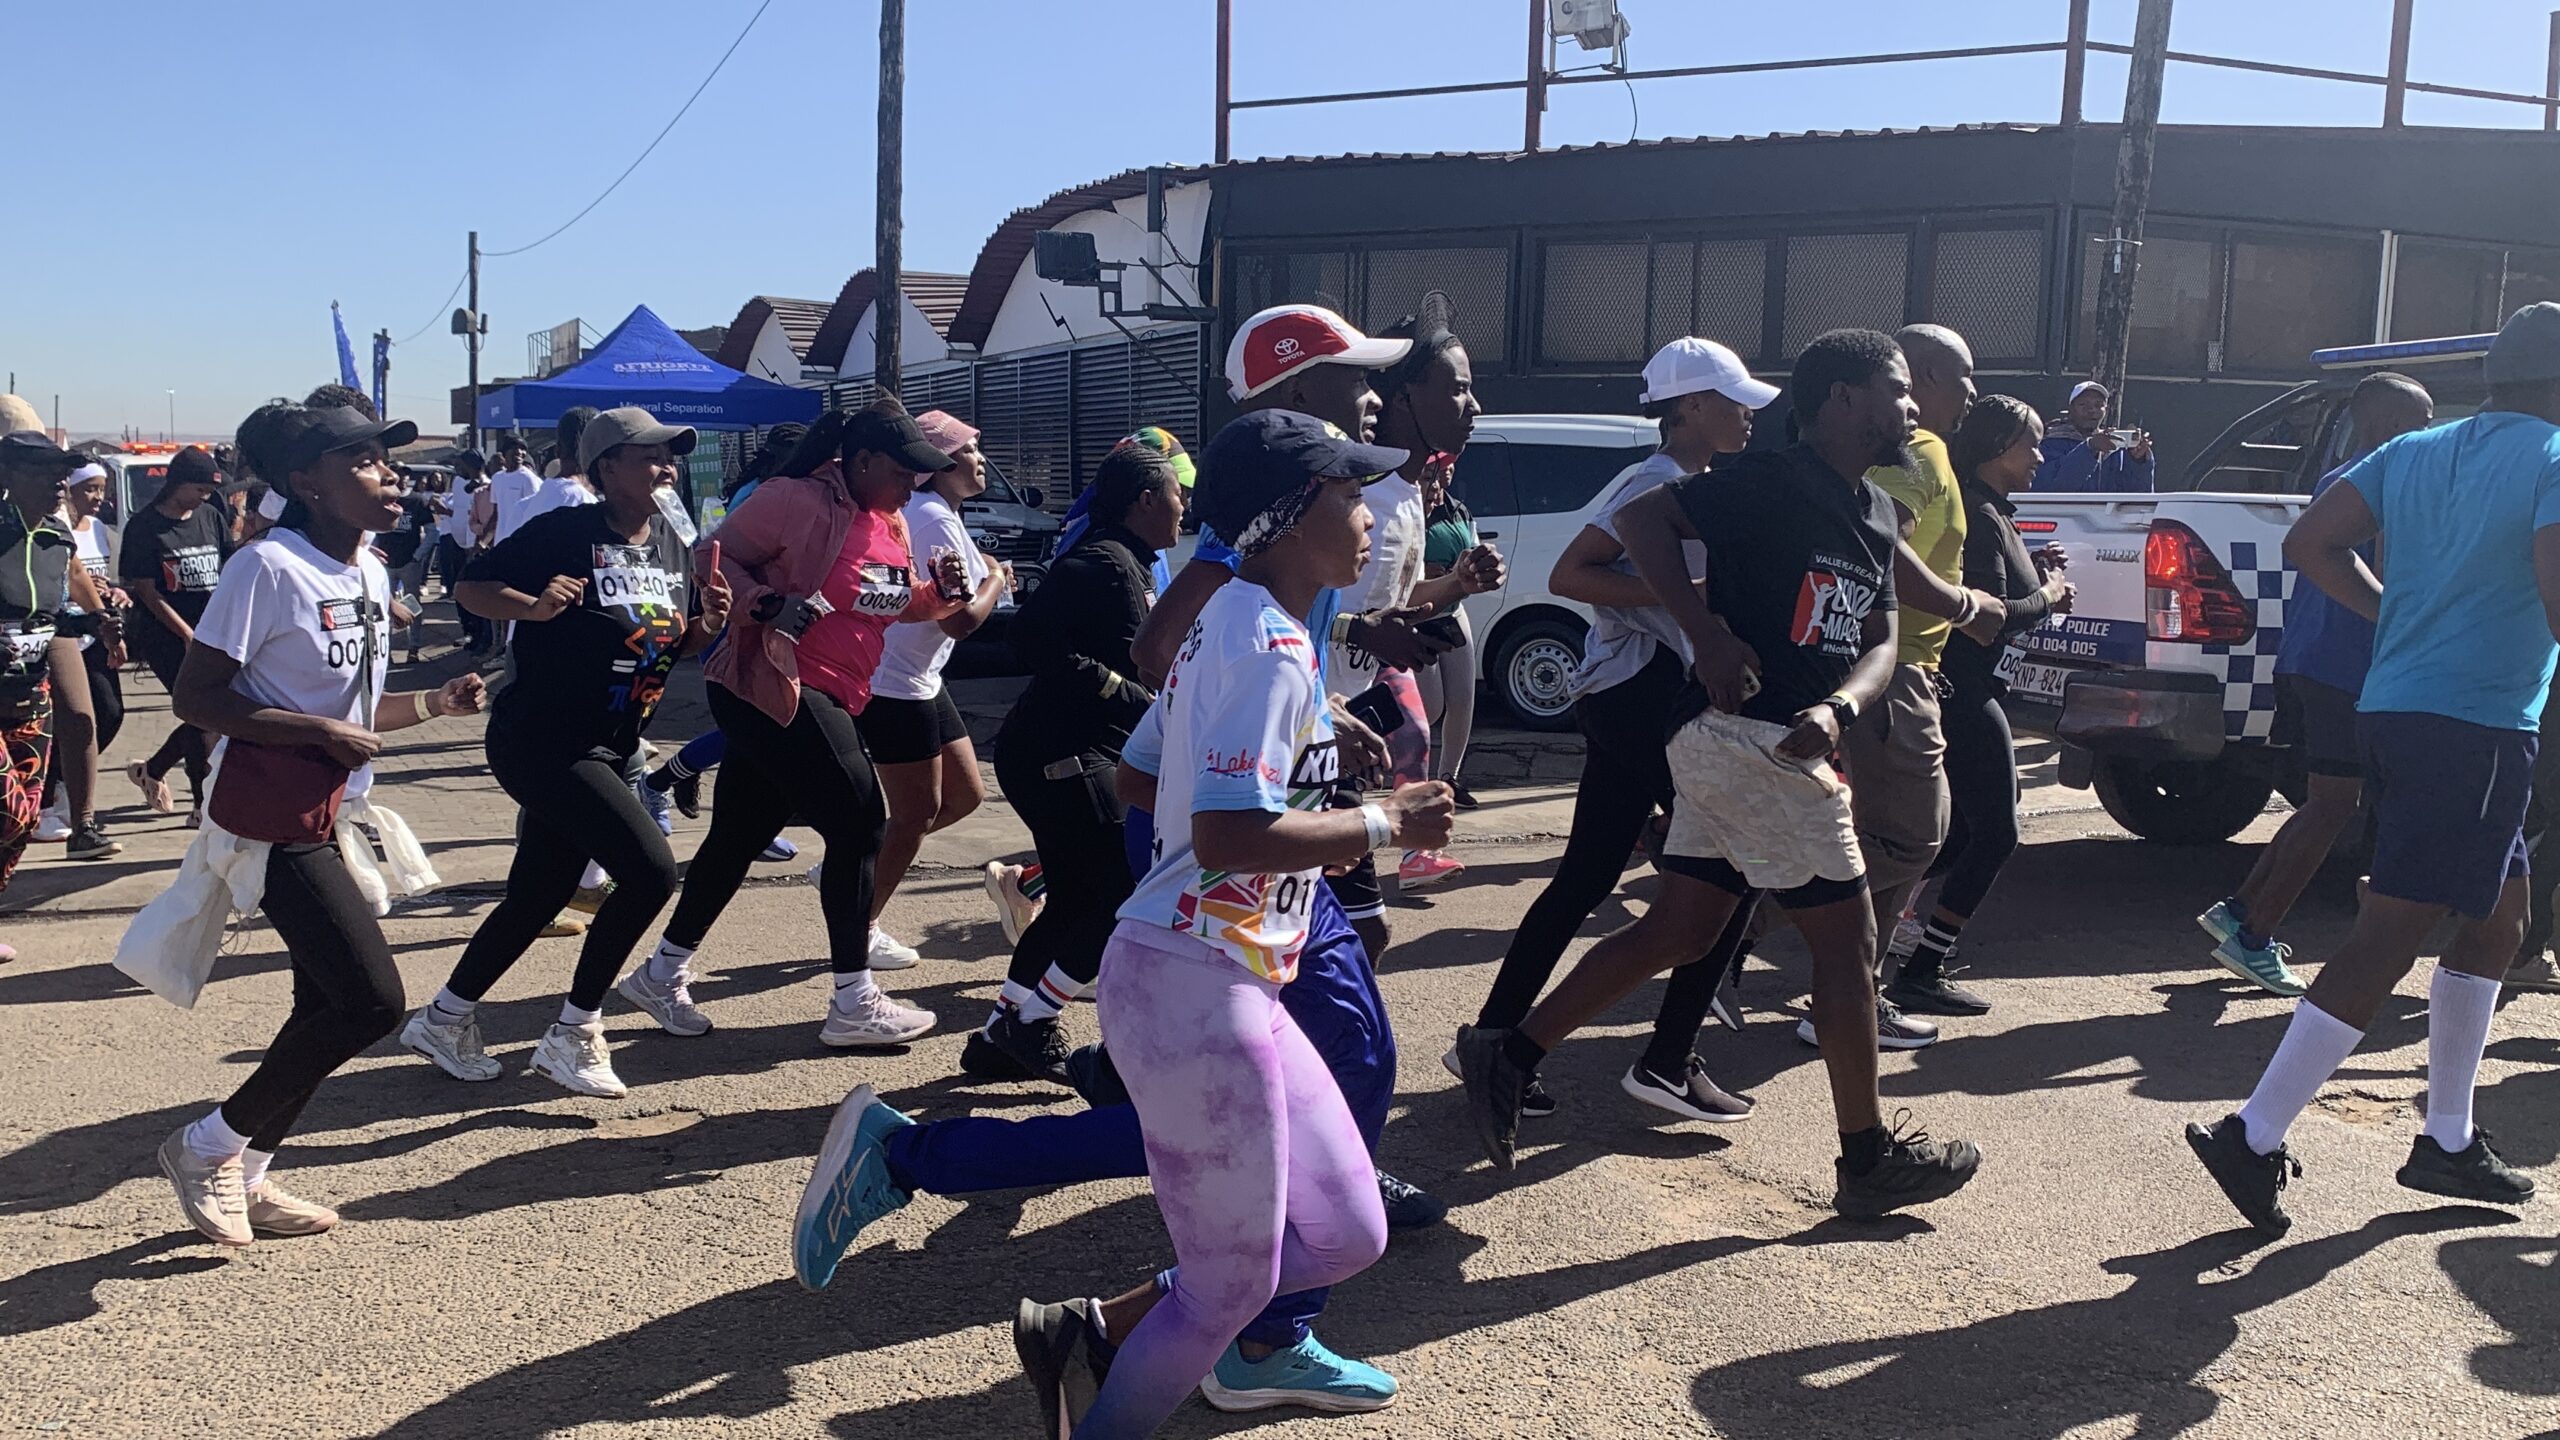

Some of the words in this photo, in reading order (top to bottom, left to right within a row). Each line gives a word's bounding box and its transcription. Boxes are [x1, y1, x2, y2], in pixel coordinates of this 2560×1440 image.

[1278, 351, 1306, 364] TOYOTA
[664, 401, 723, 414] Separation
[181, 554, 219, 575] GROOV
[183, 572, 219, 587] MARATH
[859, 590, 909, 610] 00340
[2066, 620, 2110, 637] POLICE
[2043, 637, 2068, 653] 004
[2071, 641, 2098, 656] 005
[2041, 669, 2064, 694] 824
[1276, 875, 1313, 917] 01
